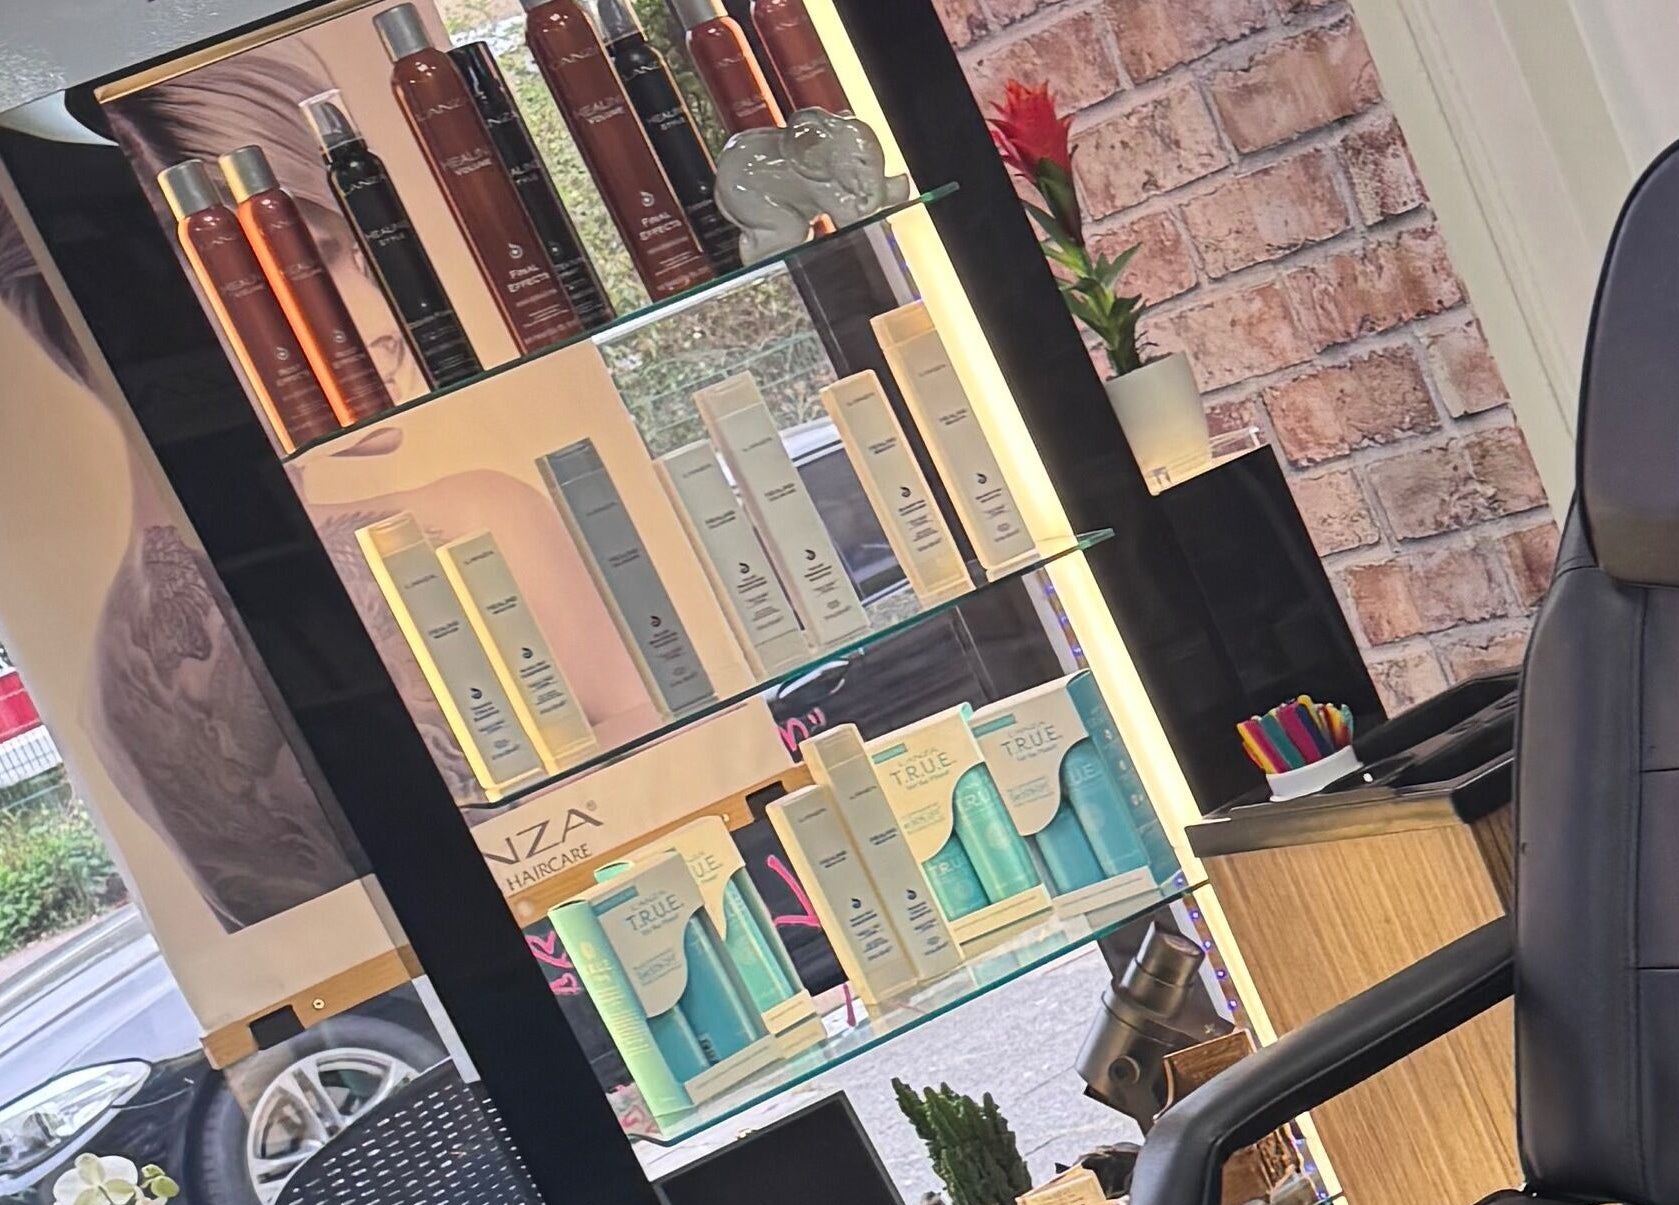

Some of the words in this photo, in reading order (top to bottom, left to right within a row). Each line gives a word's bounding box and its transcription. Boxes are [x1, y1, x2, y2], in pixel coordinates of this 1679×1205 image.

[638, 219, 683, 242] EFFECTS
[639, 211, 672, 229] FINAL
[506, 271, 551, 294] EFFECTS
[508, 264, 540, 280] FINAL
[505, 843, 593, 892] HAIRCARE
